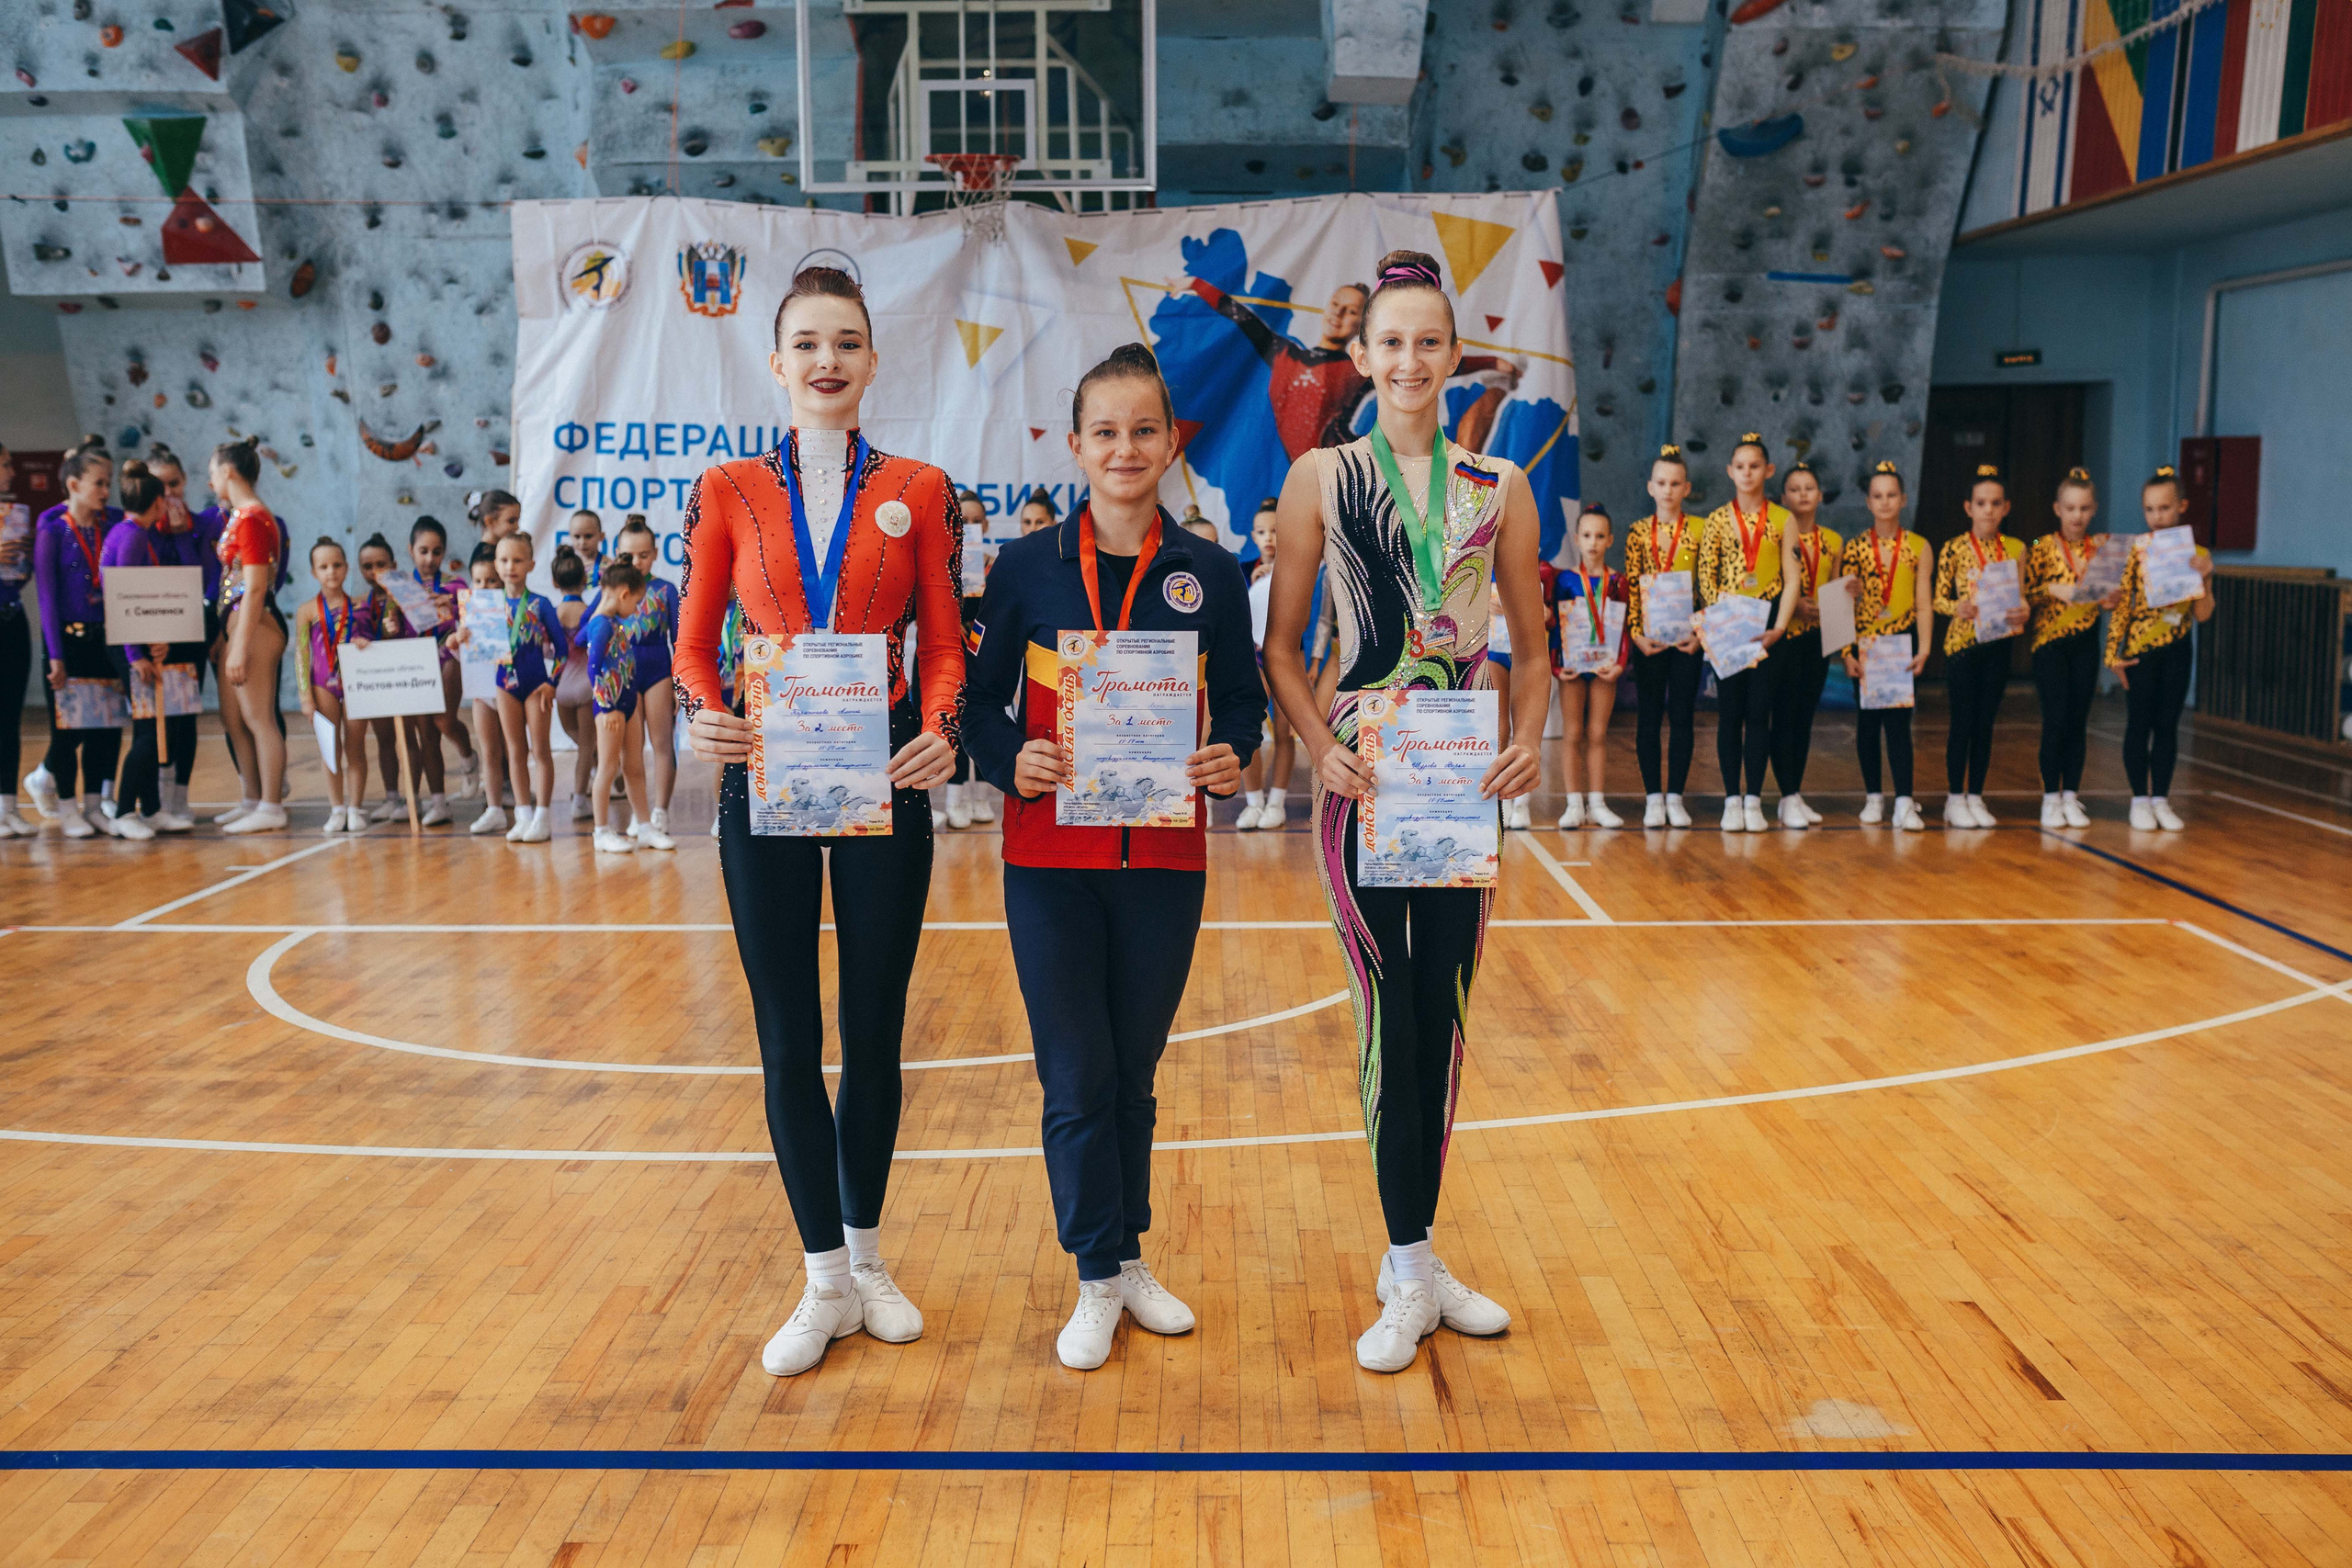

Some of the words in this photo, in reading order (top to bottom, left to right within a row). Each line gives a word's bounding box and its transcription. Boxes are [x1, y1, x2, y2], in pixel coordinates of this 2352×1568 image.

[554, 476, 691, 510] СПОРТ
[134, 606, 184, 616] Смоленск
[1407, 630, 1425, 658] 3
[356, 677, 436, 692] Ростов-на-Дону
[780, 675, 880, 709] Грамота
[1063, 673, 1075, 722] ОСЕНЬ
[1092, 670, 1191, 703] Грамота
[752, 680, 763, 728] ОСЕНЬ
[1107, 714, 1121, 725] За
[1126, 716, 1133, 725] 1
[1137, 717, 1173, 725] место
[796, 720, 811, 732] За
[815, 723, 823, 732] 2
[828, 723, 864, 732] место
[1365, 734, 1375, 770] СЕНЬ
[1392, 729, 1491, 762] Грамота
[1408, 773, 1422, 784] За
[1426, 777, 1431, 785] 3
[1364, 793, 1375, 852] ДОНСКА
